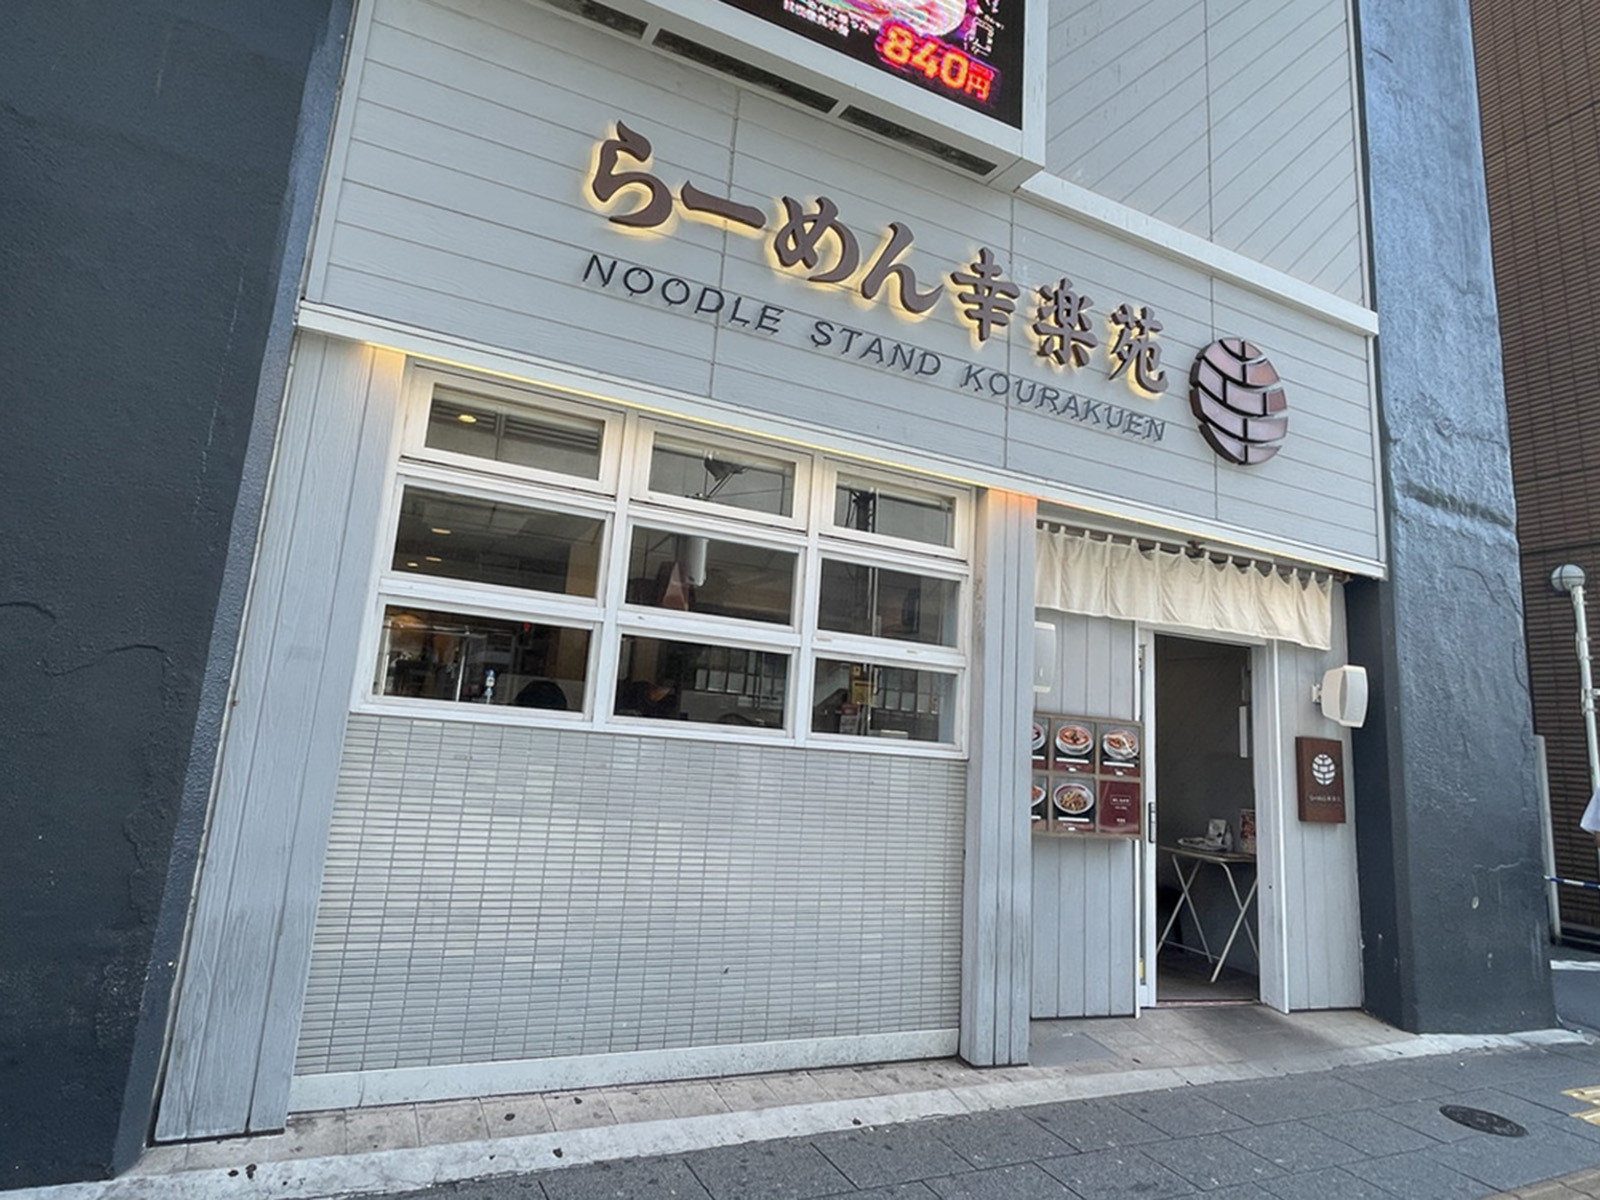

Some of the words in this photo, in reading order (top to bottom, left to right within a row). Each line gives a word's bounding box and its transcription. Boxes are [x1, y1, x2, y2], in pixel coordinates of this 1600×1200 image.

[582, 254, 785, 334] NOODLE
[810, 321, 942, 377] STAND
[960, 364, 1167, 442] KOURAKUEN
[591, 120, 1168, 394] らーめん幸楽苑
